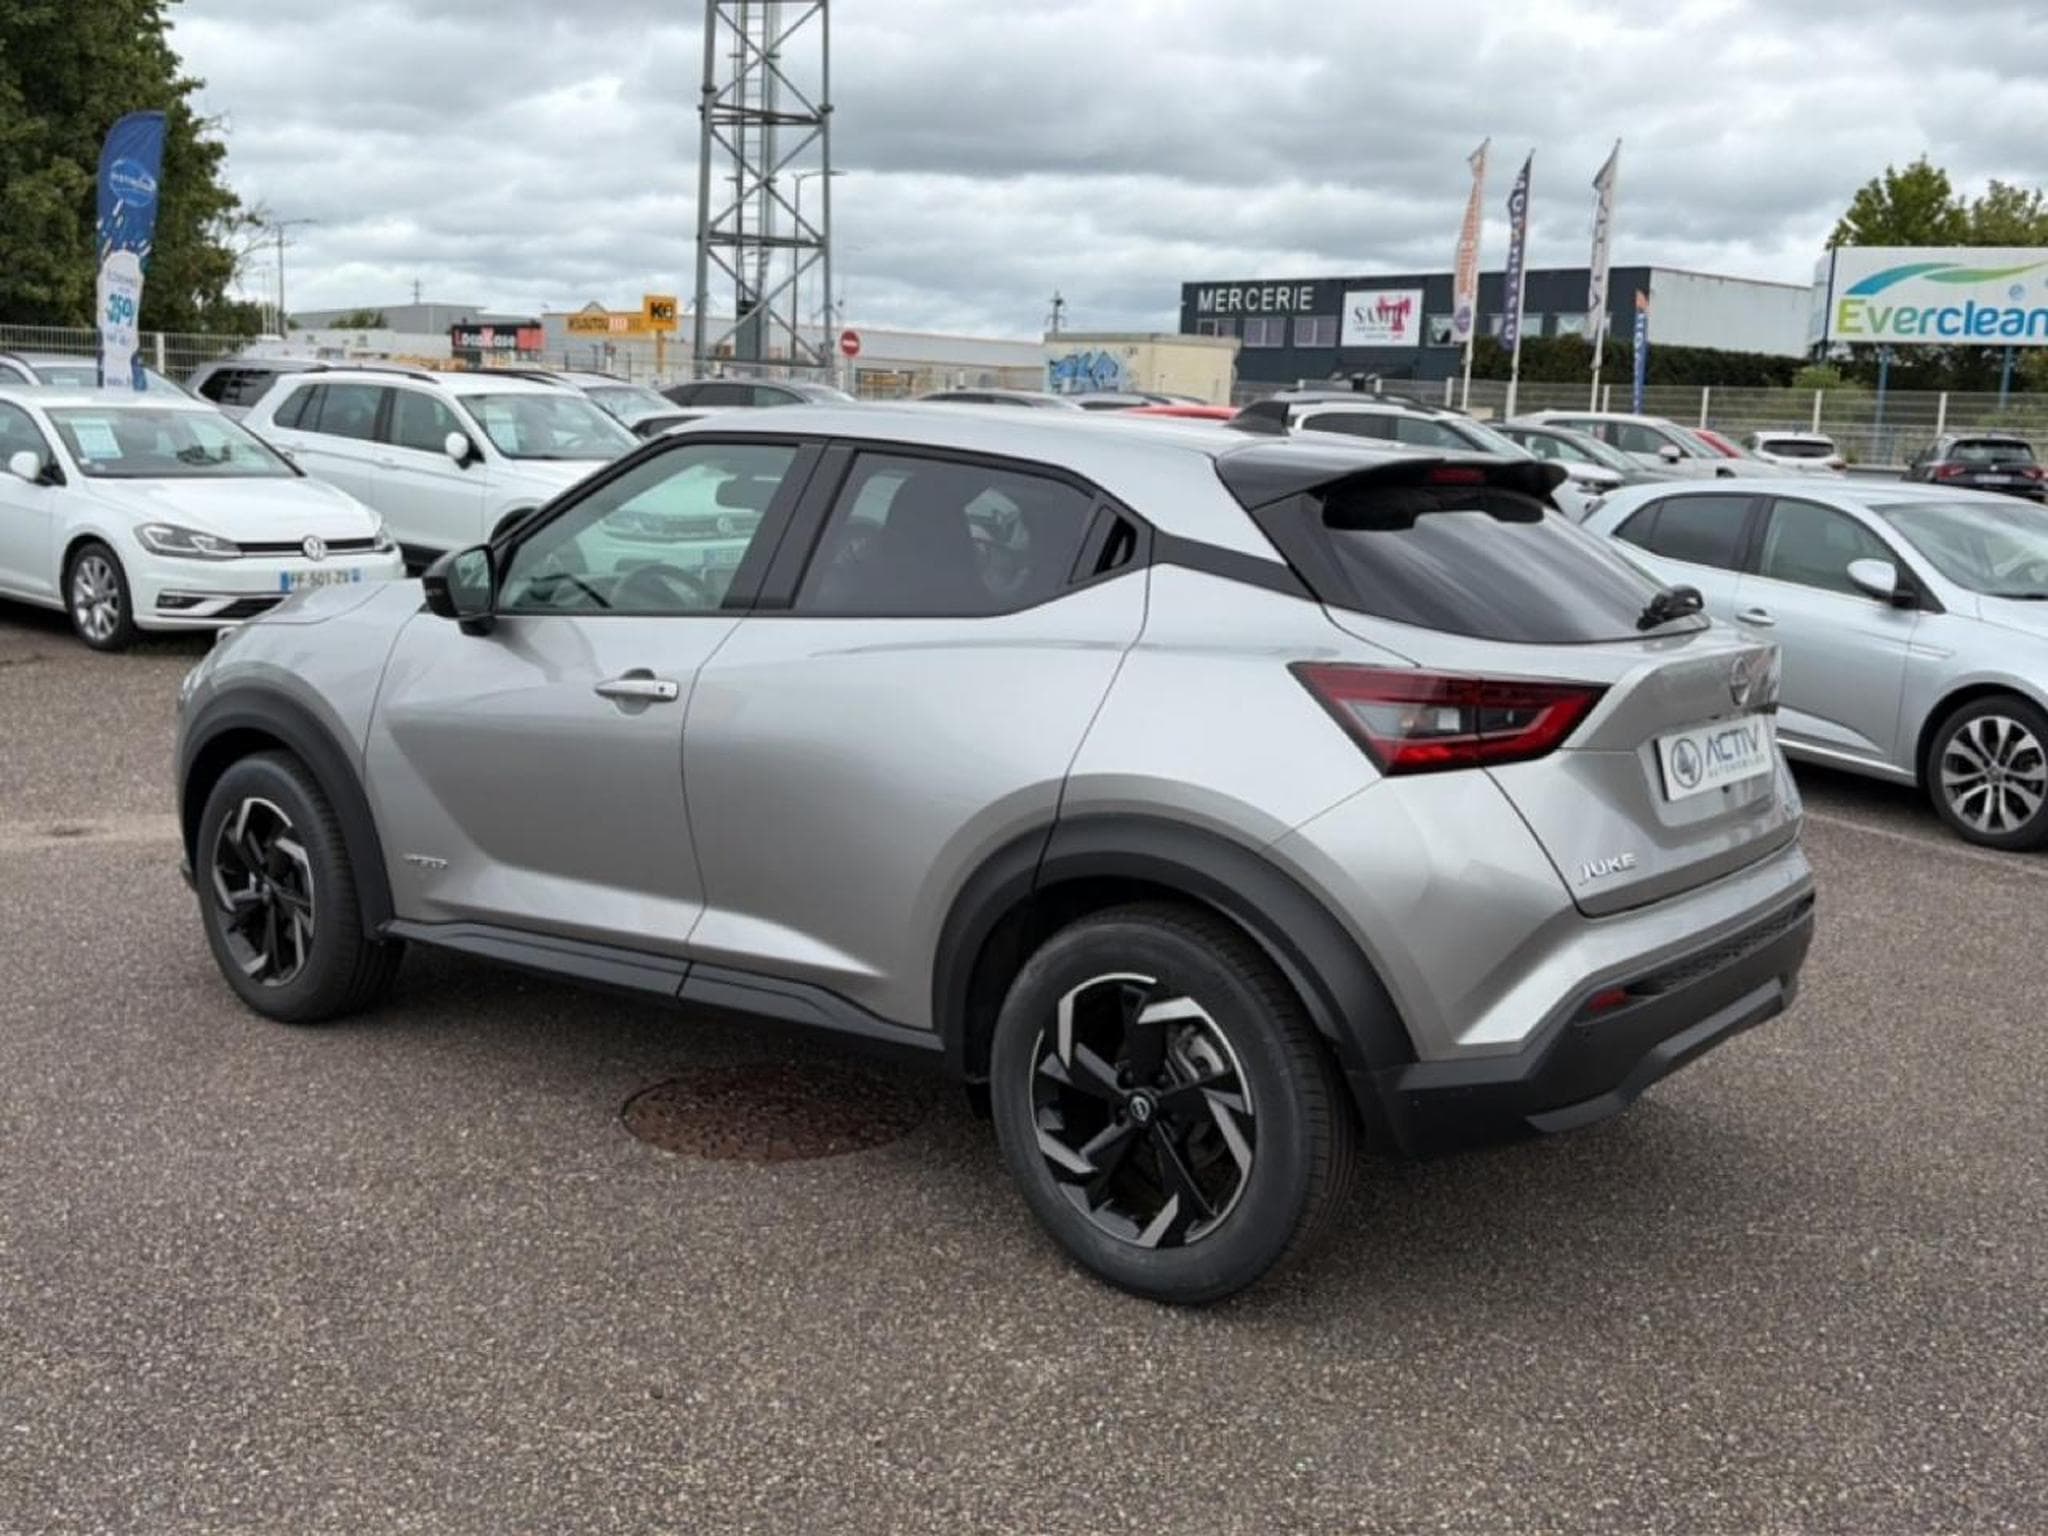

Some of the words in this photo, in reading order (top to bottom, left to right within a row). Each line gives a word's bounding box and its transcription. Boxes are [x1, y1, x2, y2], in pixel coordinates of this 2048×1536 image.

[1197, 286, 1314, 312] MERCERIE
[1837, 299, 2048, 337] Everclean
[1706, 723, 1758, 768] ACTIV
[1580, 853, 1636, 881] JUKE
